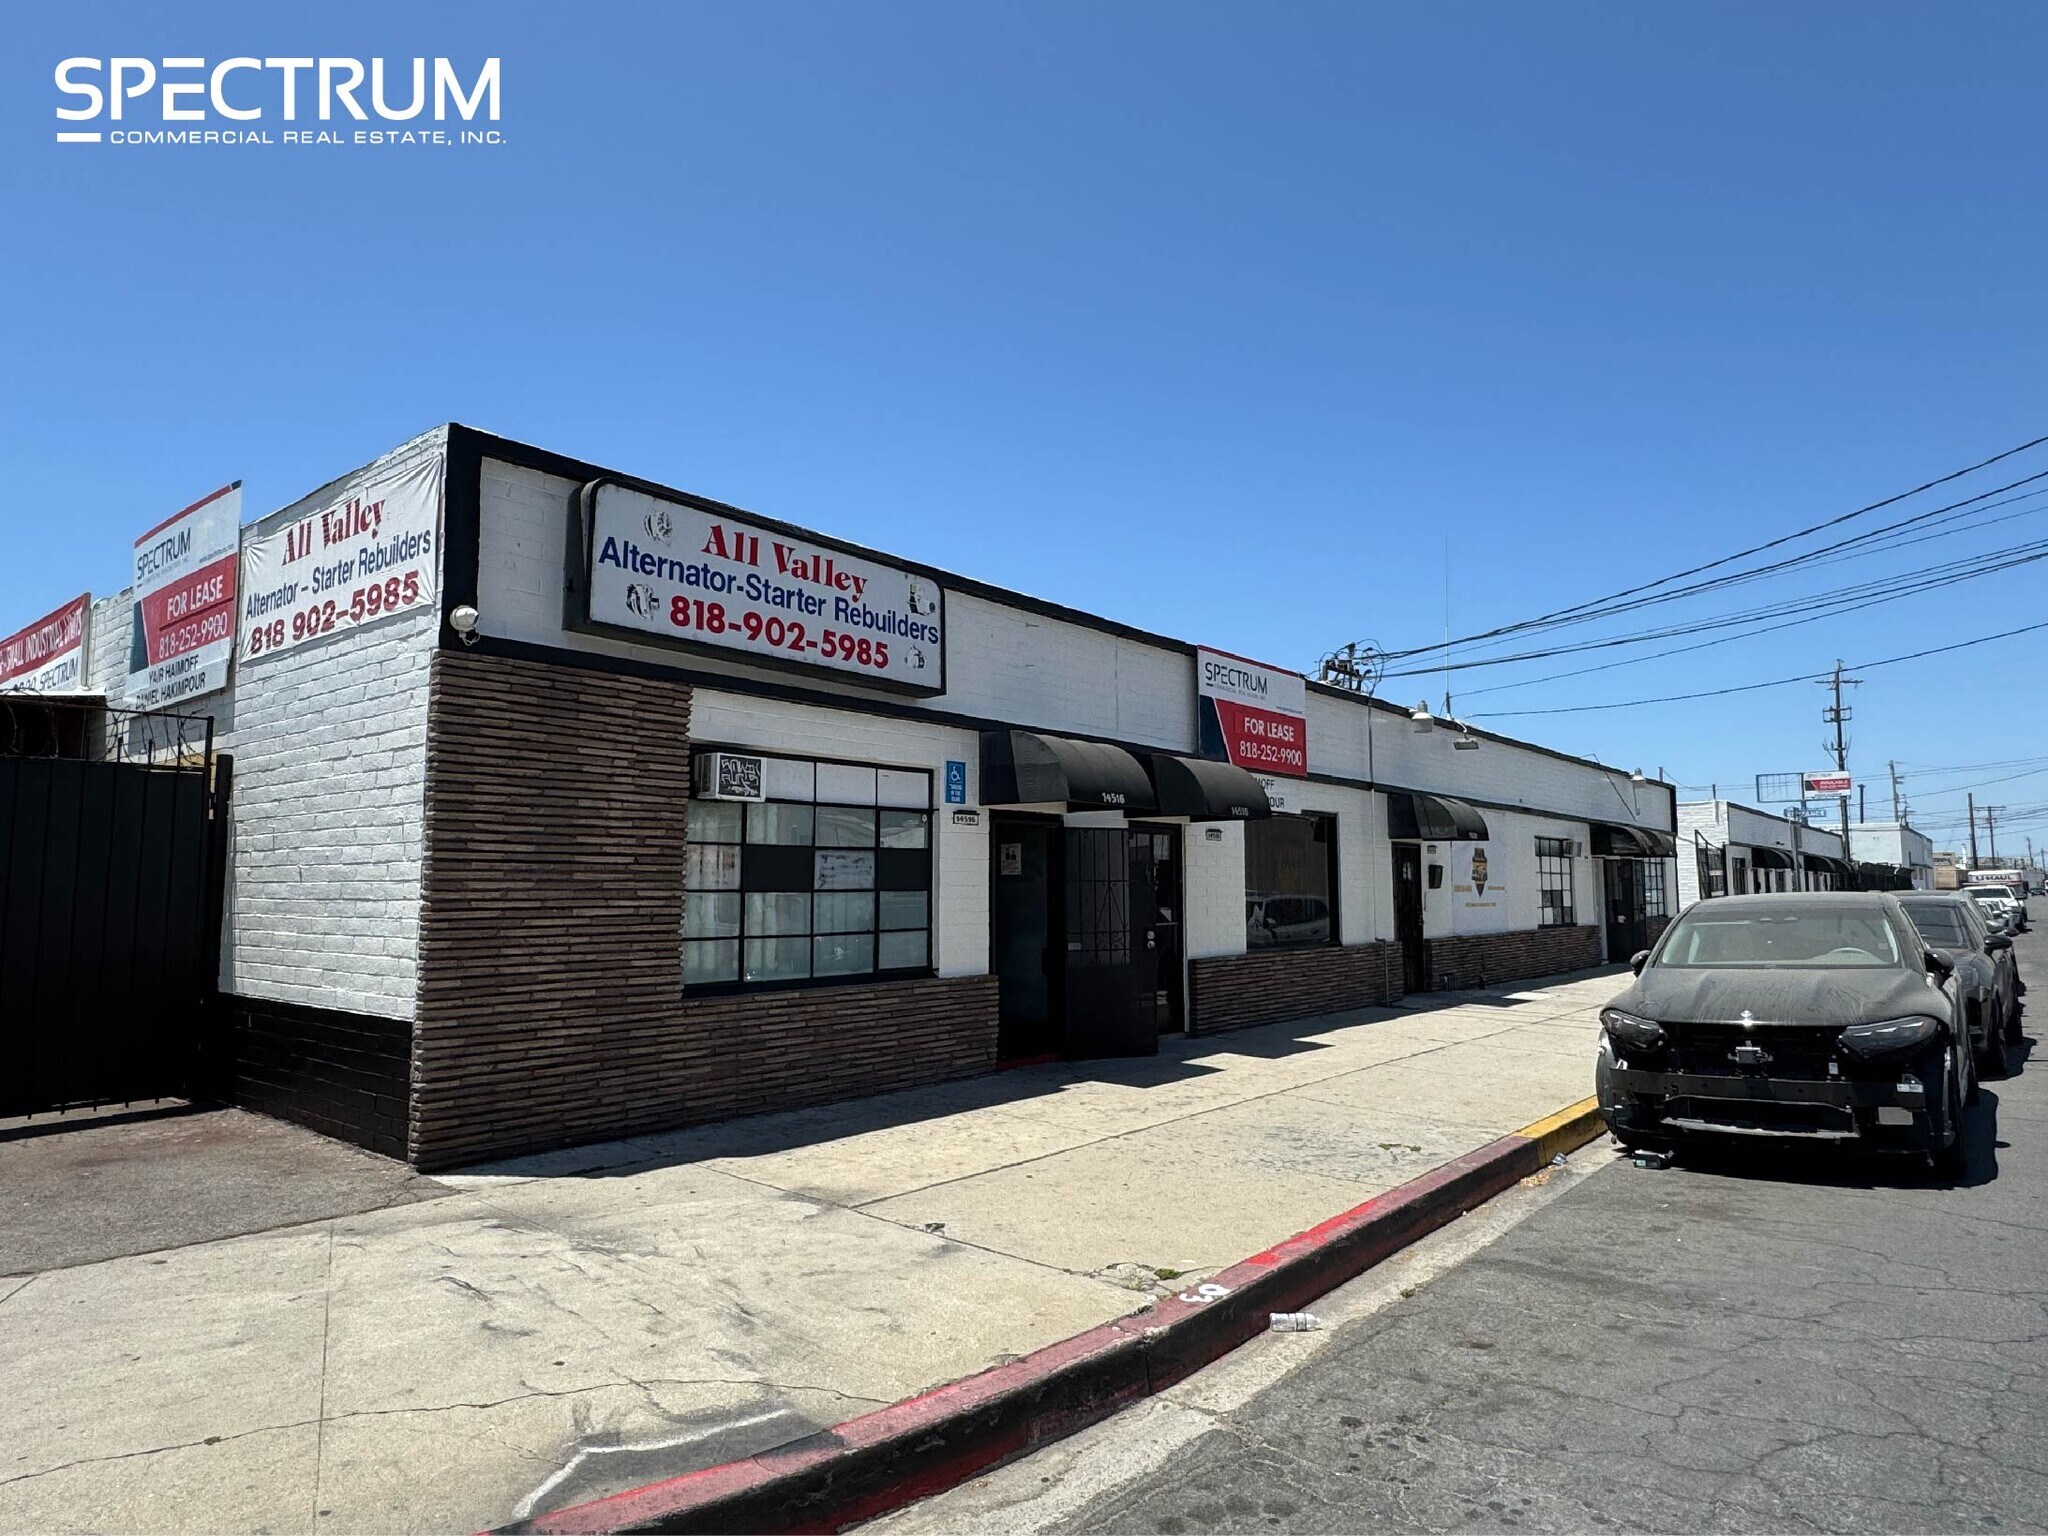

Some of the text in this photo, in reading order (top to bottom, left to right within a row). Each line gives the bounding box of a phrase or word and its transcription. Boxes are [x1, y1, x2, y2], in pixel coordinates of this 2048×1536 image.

[137, 527, 191, 581] SPECTRUM
[282, 520, 312, 566] All
[321, 498, 386, 549] Valley
[246, 581, 299, 621] Alternator
[312, 559, 356, 594] Starter
[357, 529, 431, 578] Rebuilders
[701, 524, 869, 603] All Valley
[168, 575, 224, 621] FOR LEASE
[250, 570, 419, 654] 818 902-5985
[598, 536, 940, 645] Alternator-Starter Rebuilders
[159, 611, 228, 659] 818-252-9900
[669, 595, 889, 669] 818-902-5985
[161, 671, 206, 701] HAKIMPOUR
[165, 654, 199, 681] HAIMOFF
[1205, 662, 1268, 695] SPECTRUM
[1240, 740, 1302, 767] 818-252-9900
[1244, 717, 1295, 742] FOR LEASE
[1102, 792, 1125, 804] 14516
